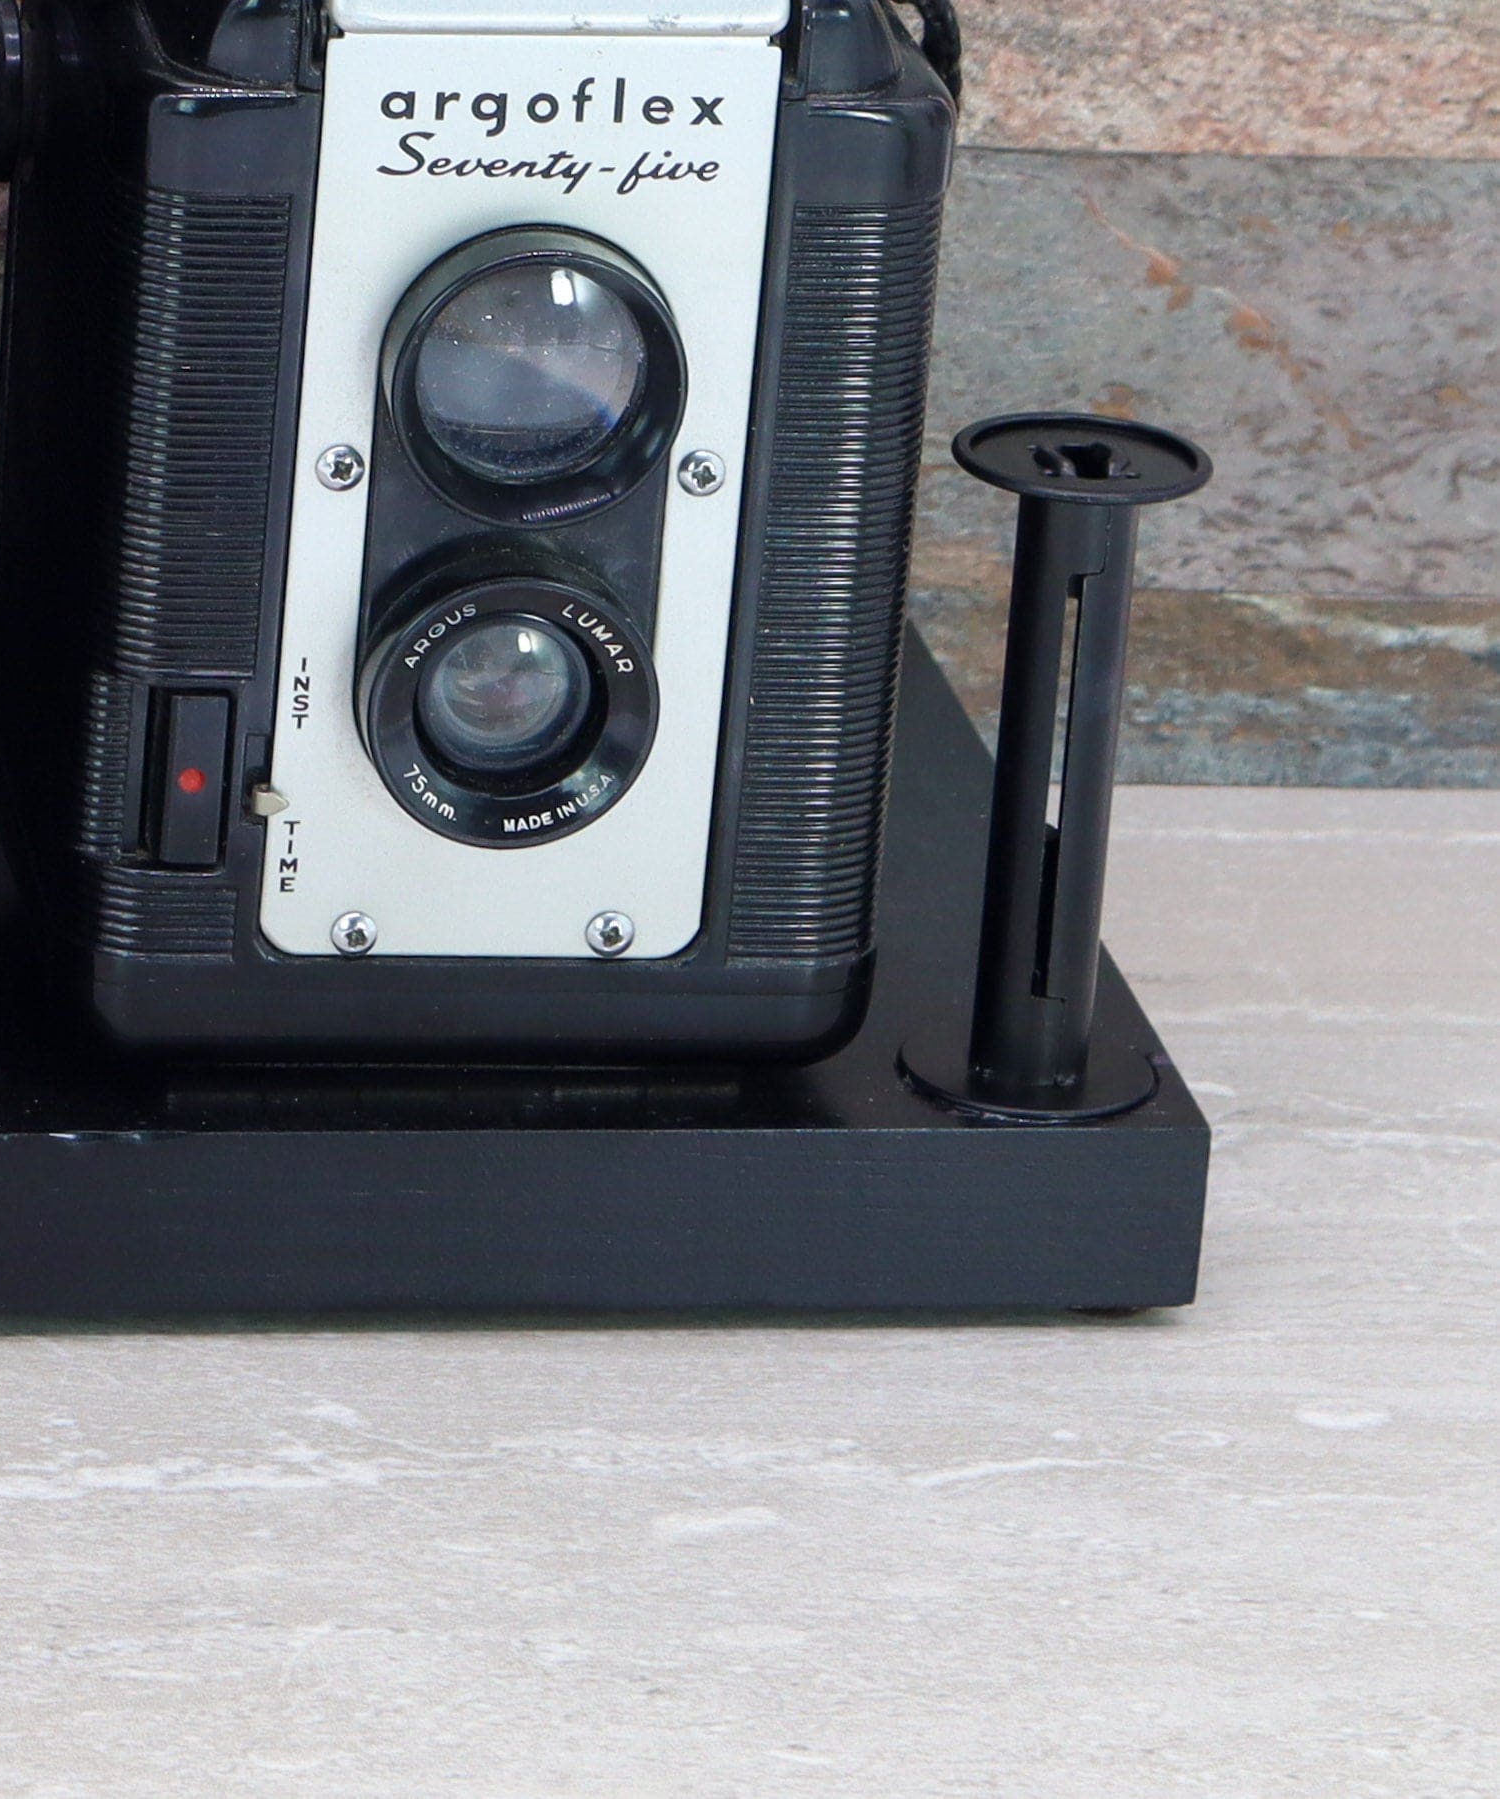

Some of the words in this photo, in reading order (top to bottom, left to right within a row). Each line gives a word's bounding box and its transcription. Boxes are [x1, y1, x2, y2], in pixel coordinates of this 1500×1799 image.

[379, 76, 725, 138] argoflex
[375, 131, 721, 196] Seventy-five
[403, 603, 478, 670] ARGUS
[561, 602, 635, 674] LUMAR
[290, 656, 311, 730] INST
[502, 811, 555, 834] MADE
[555, 801, 577, 822] IN
[278, 819, 302, 894] TIME
